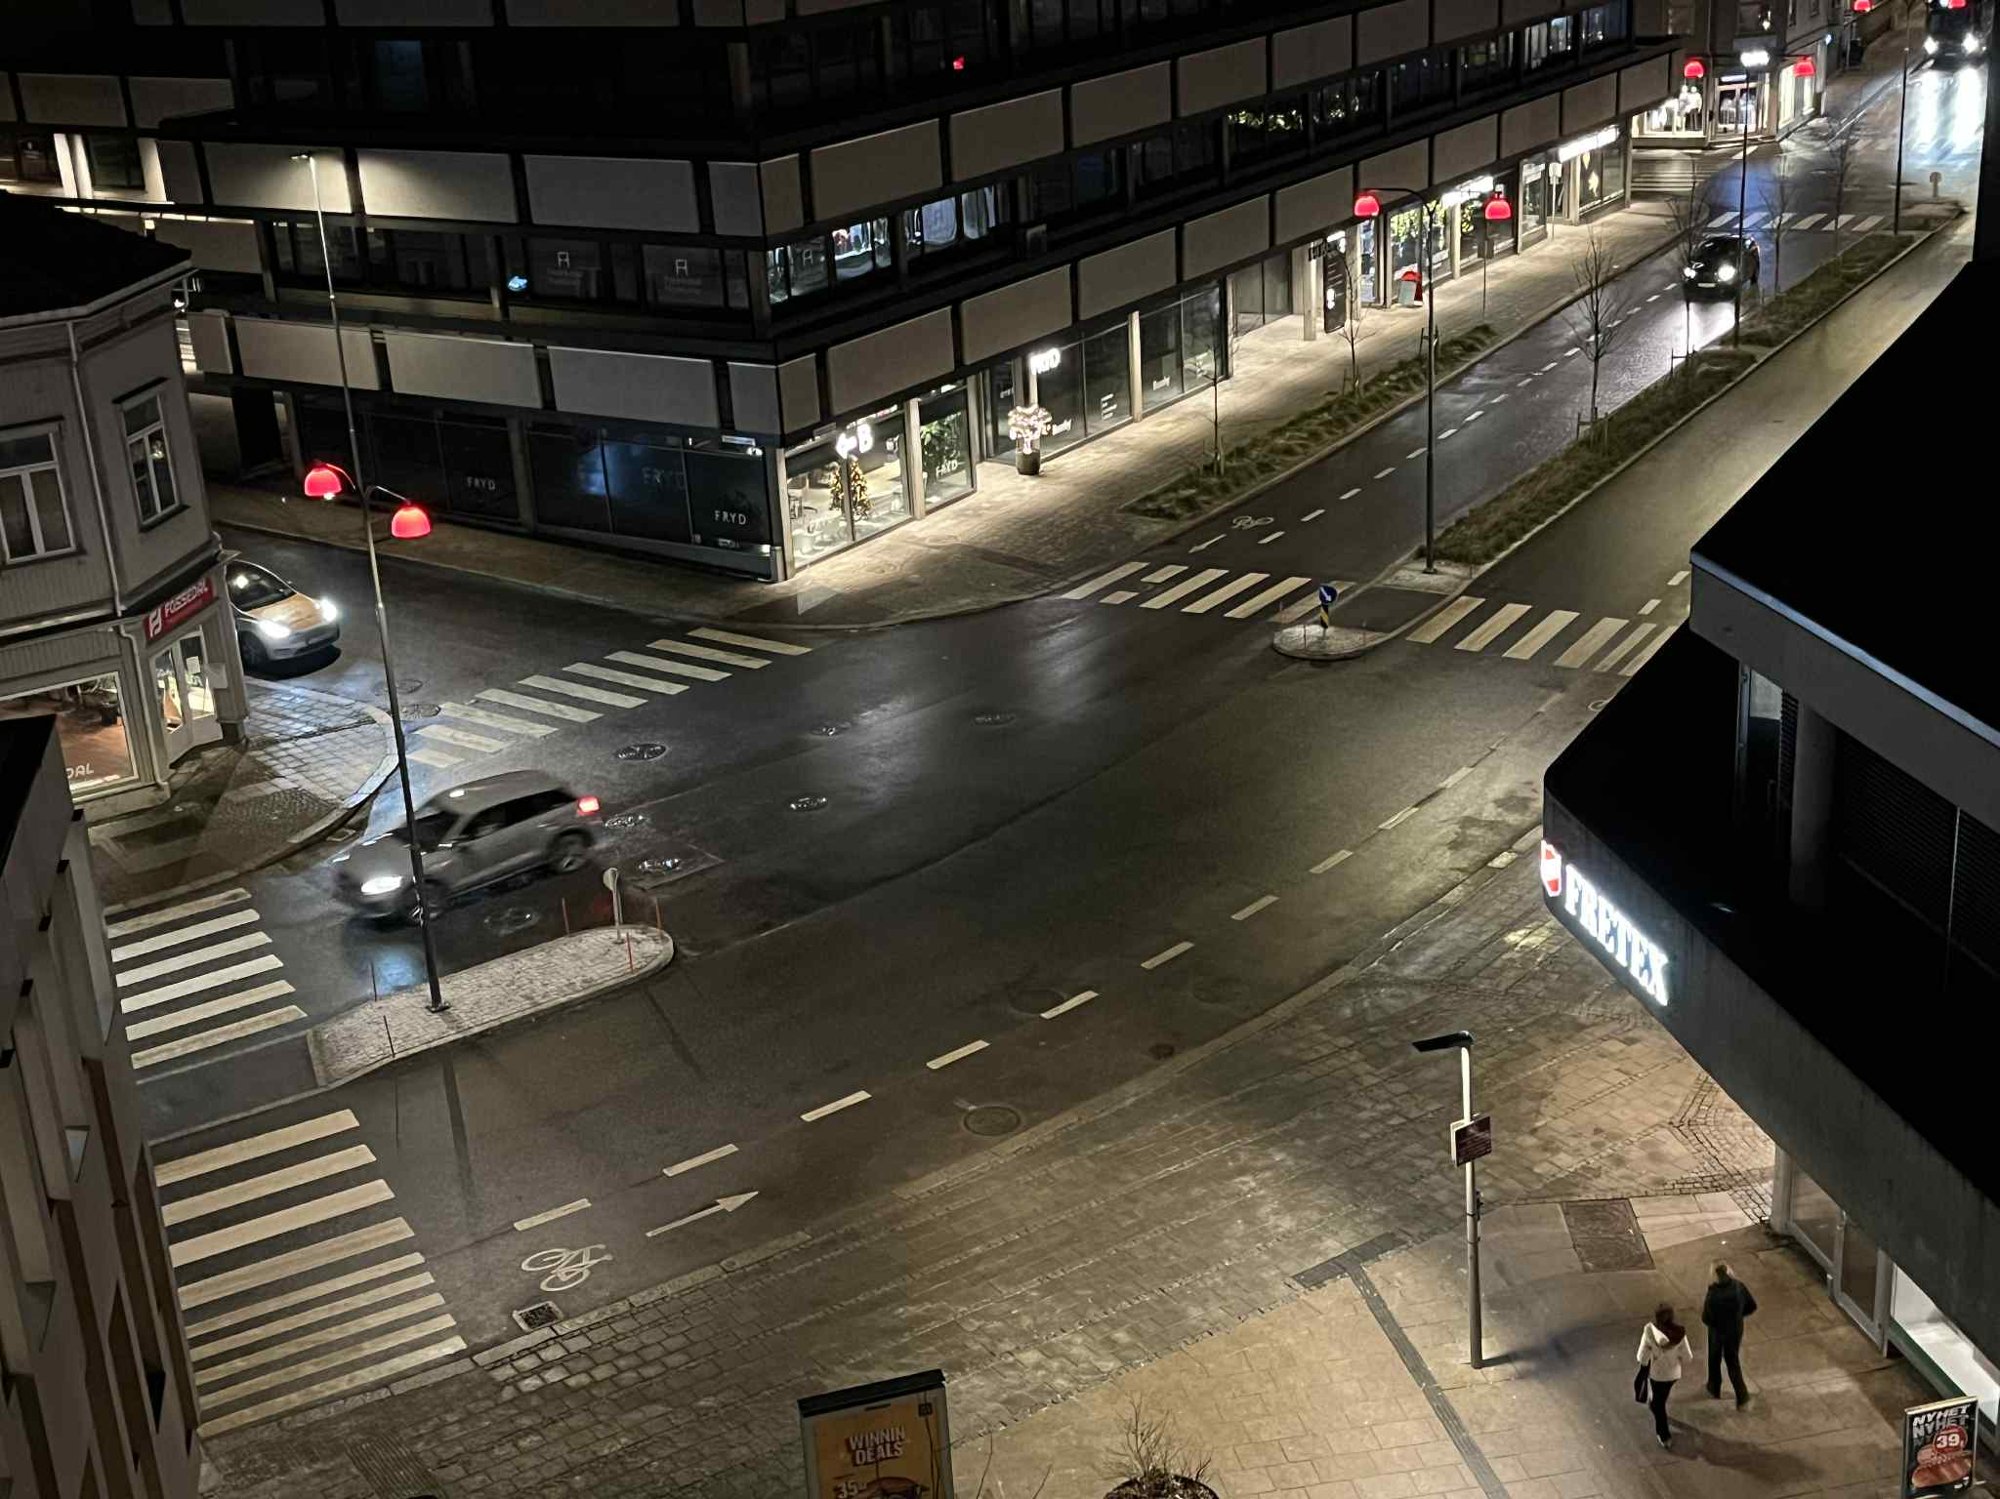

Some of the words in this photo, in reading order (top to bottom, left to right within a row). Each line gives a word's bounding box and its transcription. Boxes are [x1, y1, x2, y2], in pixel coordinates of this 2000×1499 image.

[466, 476, 496, 491] FRYD
[714, 510, 747, 525] FRYD
[1564, 863, 1669, 1007] FRETEX
[1912, 1404, 1971, 1427] NYHET
[848, 1425, 906, 1452] WINNIN
[854, 1440, 904, 1466] DEALS
